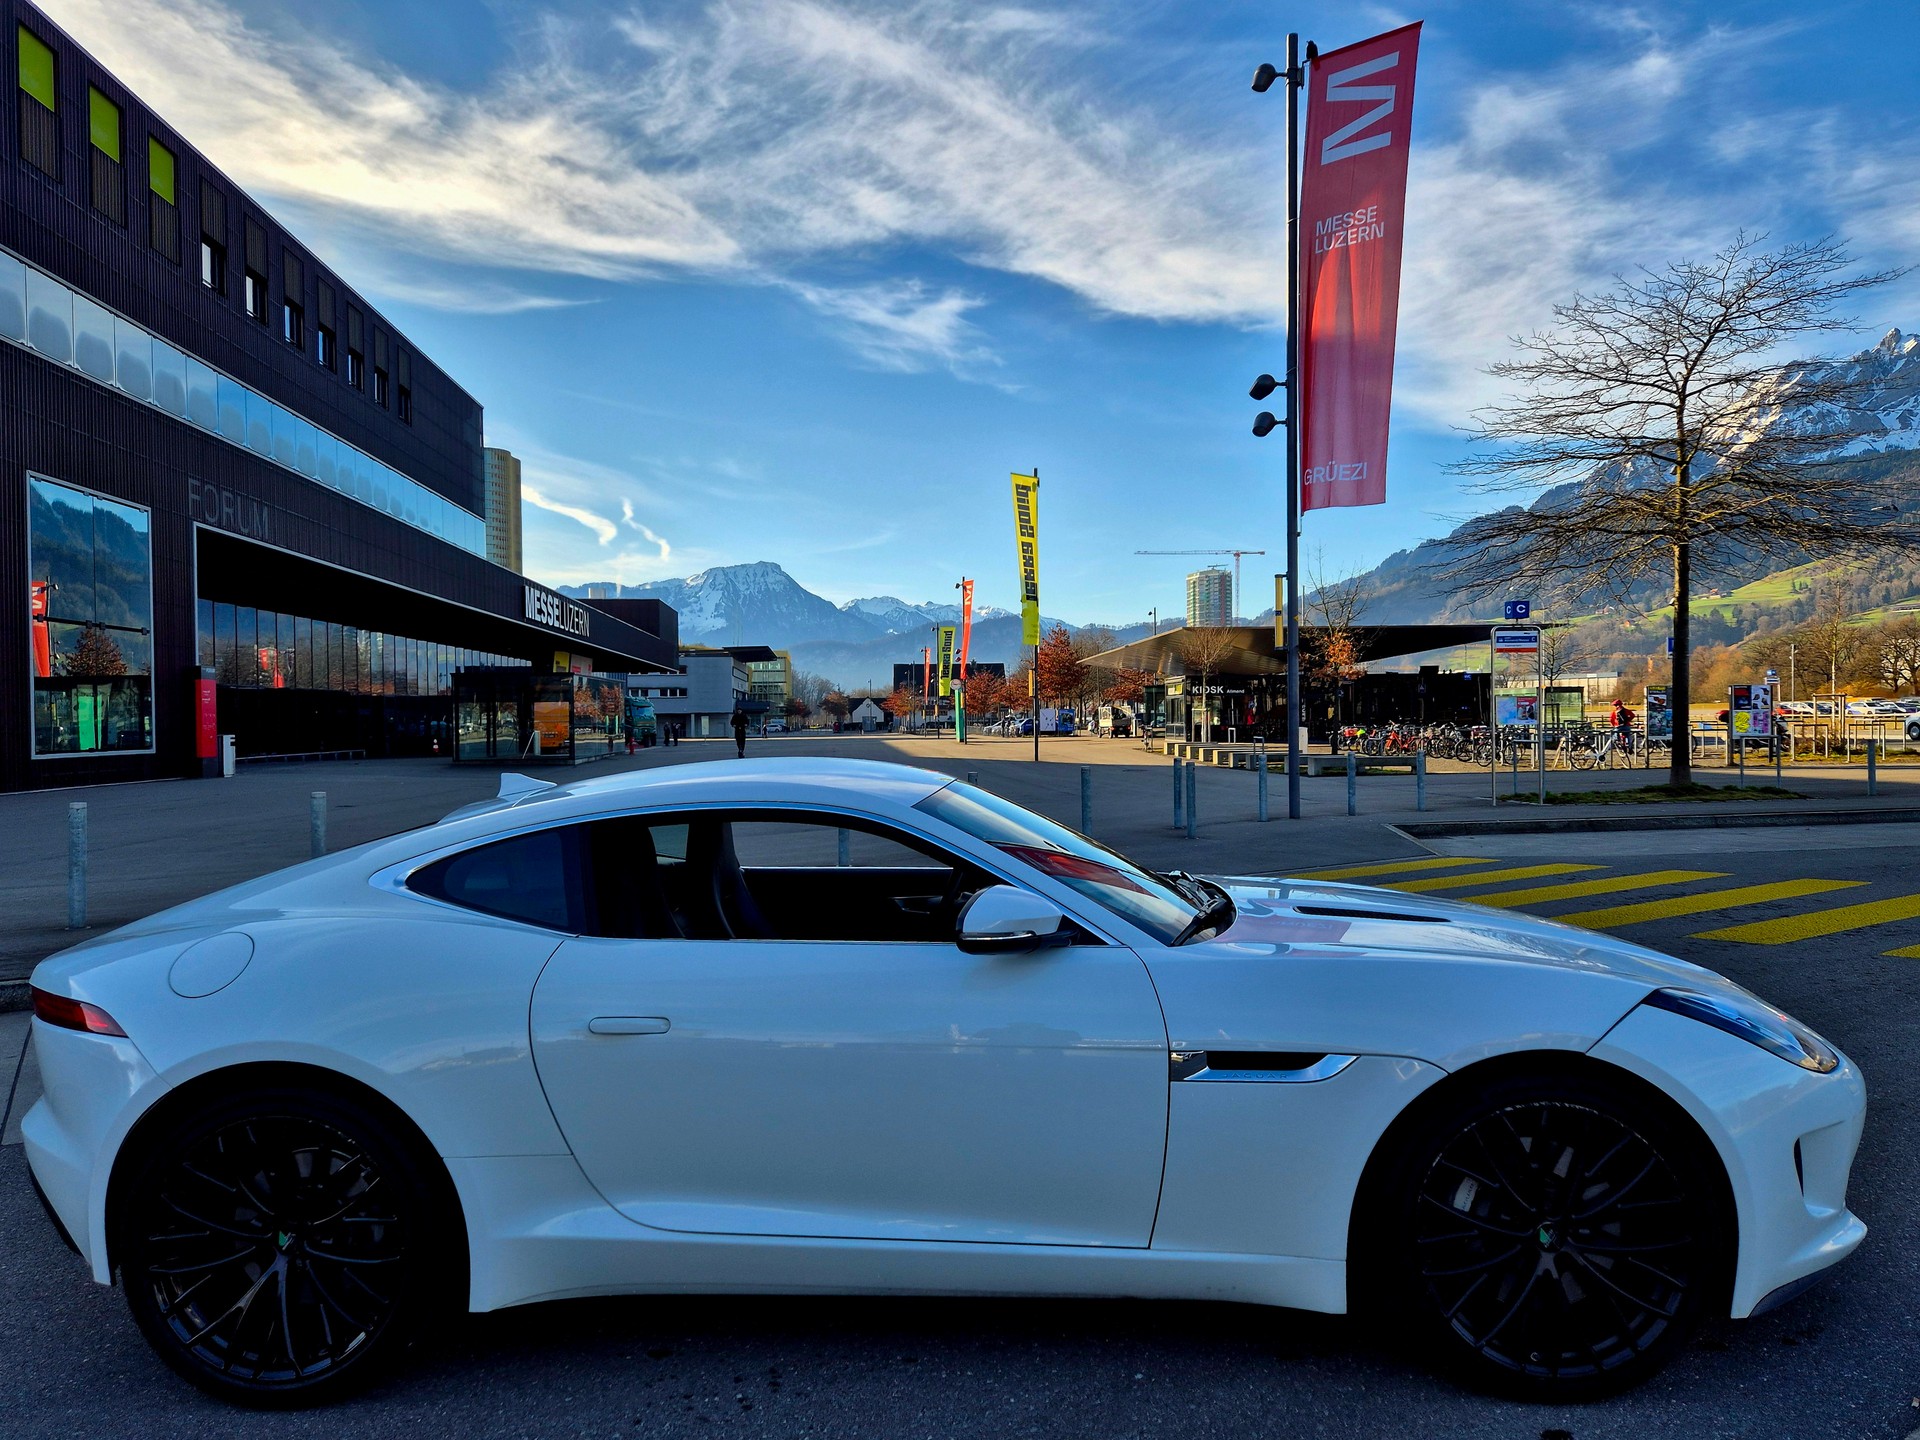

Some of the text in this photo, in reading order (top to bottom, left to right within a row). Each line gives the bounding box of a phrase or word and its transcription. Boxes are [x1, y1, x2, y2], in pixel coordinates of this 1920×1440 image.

[1316, 205, 1377, 236] MESSE
[1315, 222, 1384, 254] LUZERN
[1304, 461, 1367, 486] GRÜEZI
[188, 477, 269, 540] FORUM
[1516, 604, 1526, 614] C
[1192, 685, 1224, 694] KIOSK
